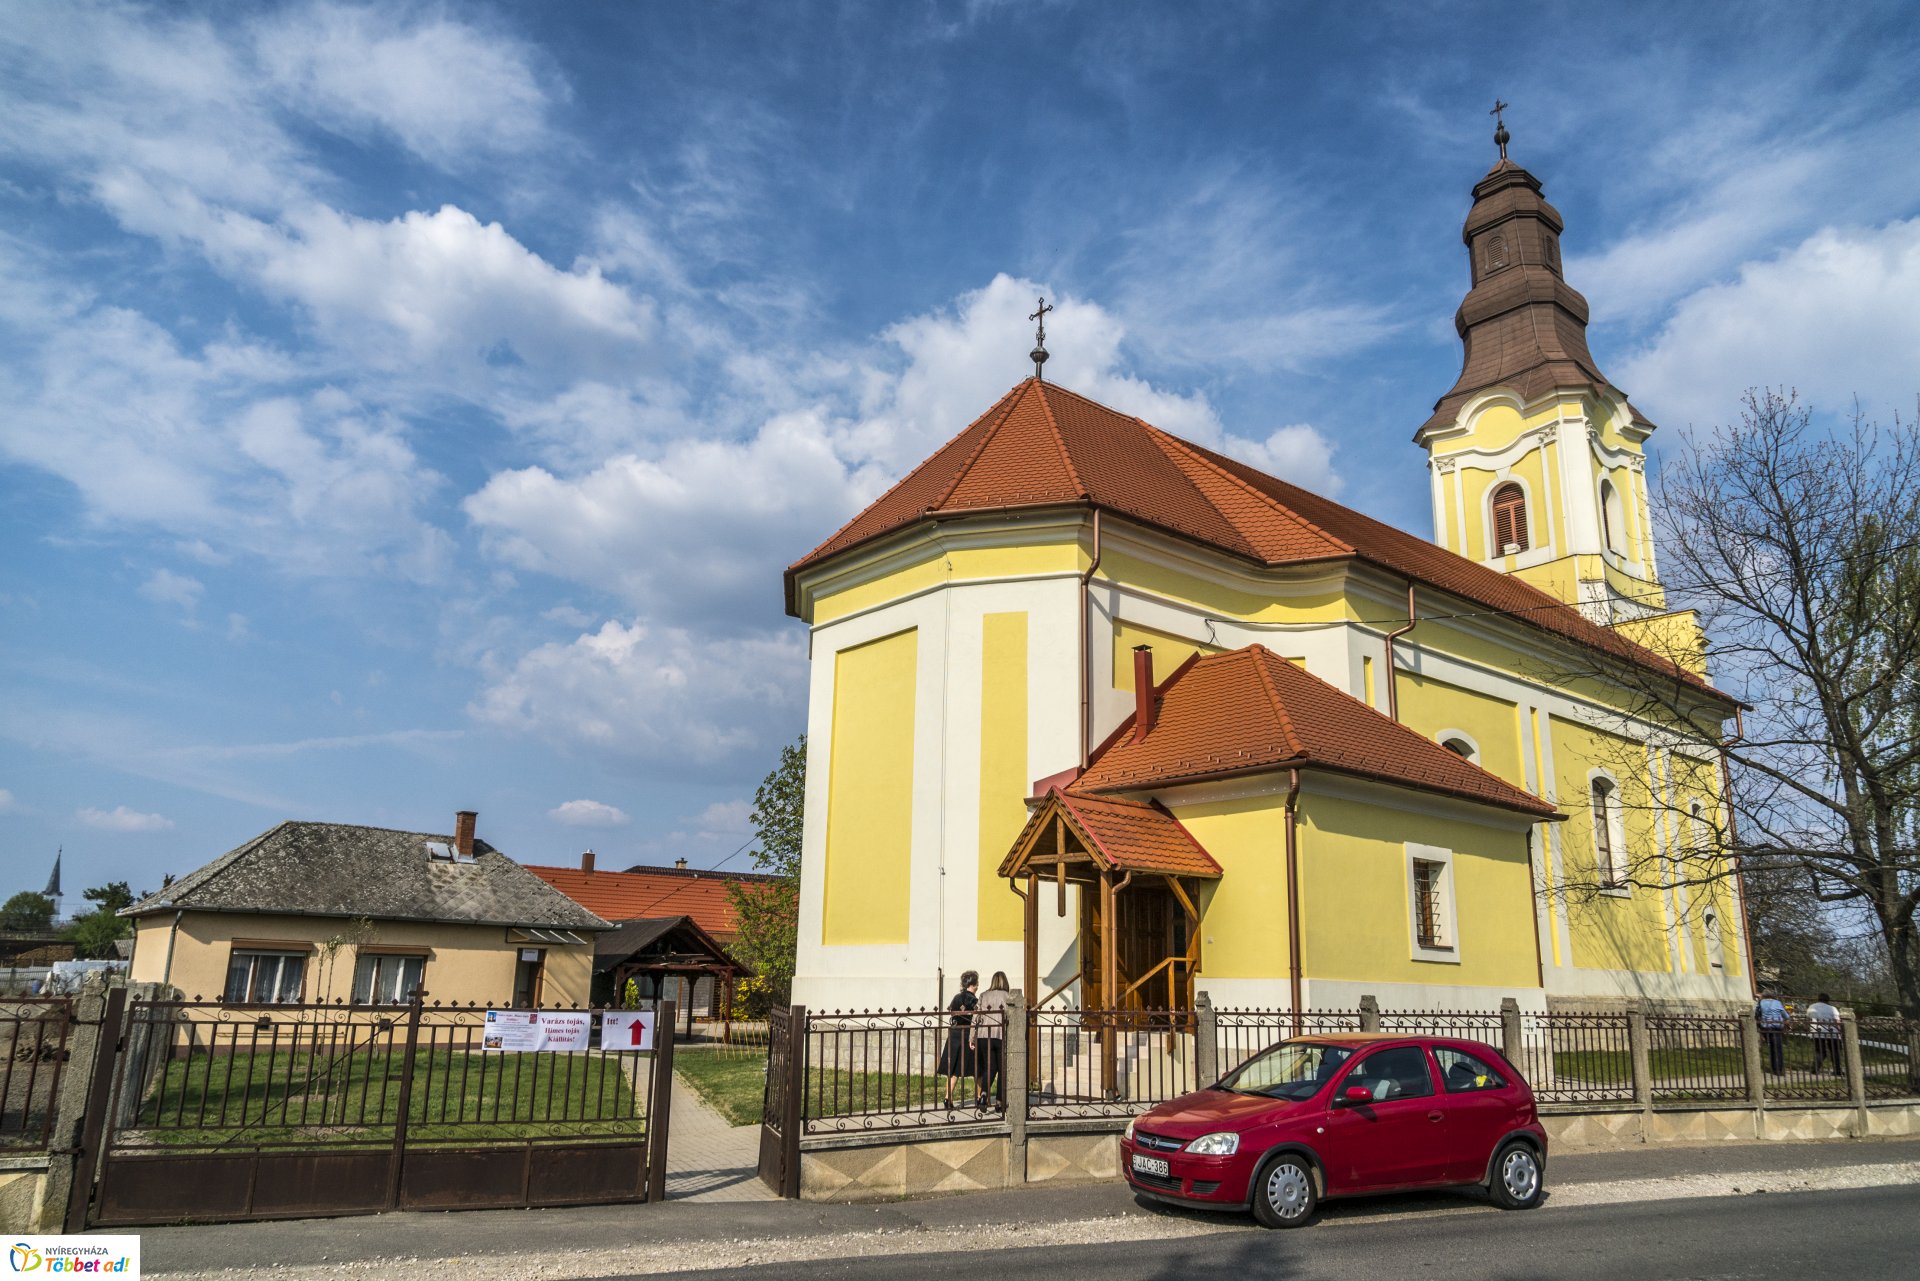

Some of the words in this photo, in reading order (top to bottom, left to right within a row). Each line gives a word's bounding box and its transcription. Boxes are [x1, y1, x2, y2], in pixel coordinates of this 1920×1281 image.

[566, 1018, 585, 1026] tojás,
[606, 1017, 619, 1025] Itt!
[1137, 1156, 1168, 1175] JAC-386
